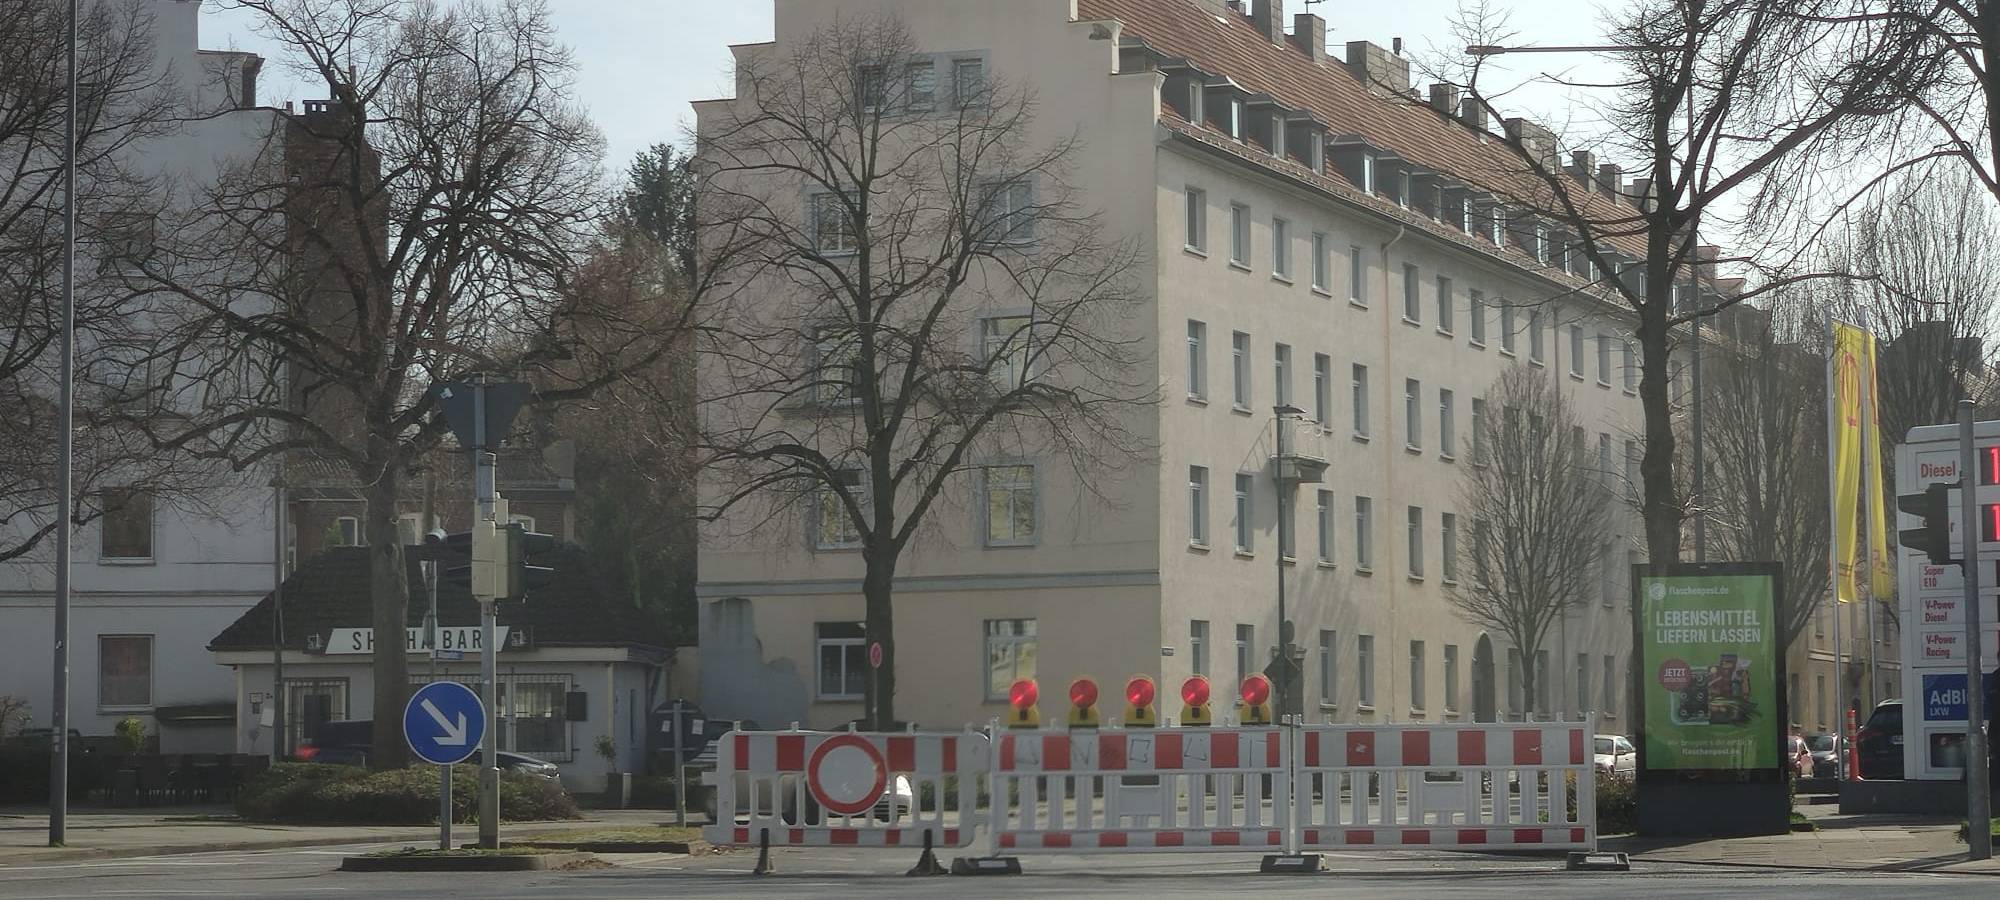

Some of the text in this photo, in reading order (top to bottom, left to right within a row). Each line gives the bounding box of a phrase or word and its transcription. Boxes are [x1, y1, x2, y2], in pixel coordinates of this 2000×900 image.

[1920, 461, 1956, 478] Diesel
[1923, 565, 1944, 577] Super
[1924, 577, 1937, 588] E10
[1925, 600, 1955, 610] V-Power
[1656, 609, 1760, 627] LEBENSMITTEL
[1925, 611, 1947, 622] Diesel
[442, 629, 482, 650] BAR
[1656, 627, 1761, 644] LIEFERN LASSEN
[1926, 634, 1957, 645] V-Power
[1926, 647, 1950, 659] Racing
[1664, 667, 1685, 677] JETZT
[1930, 688, 1969, 705] AdBl
[1930, 706, 1950, 716] LKW
